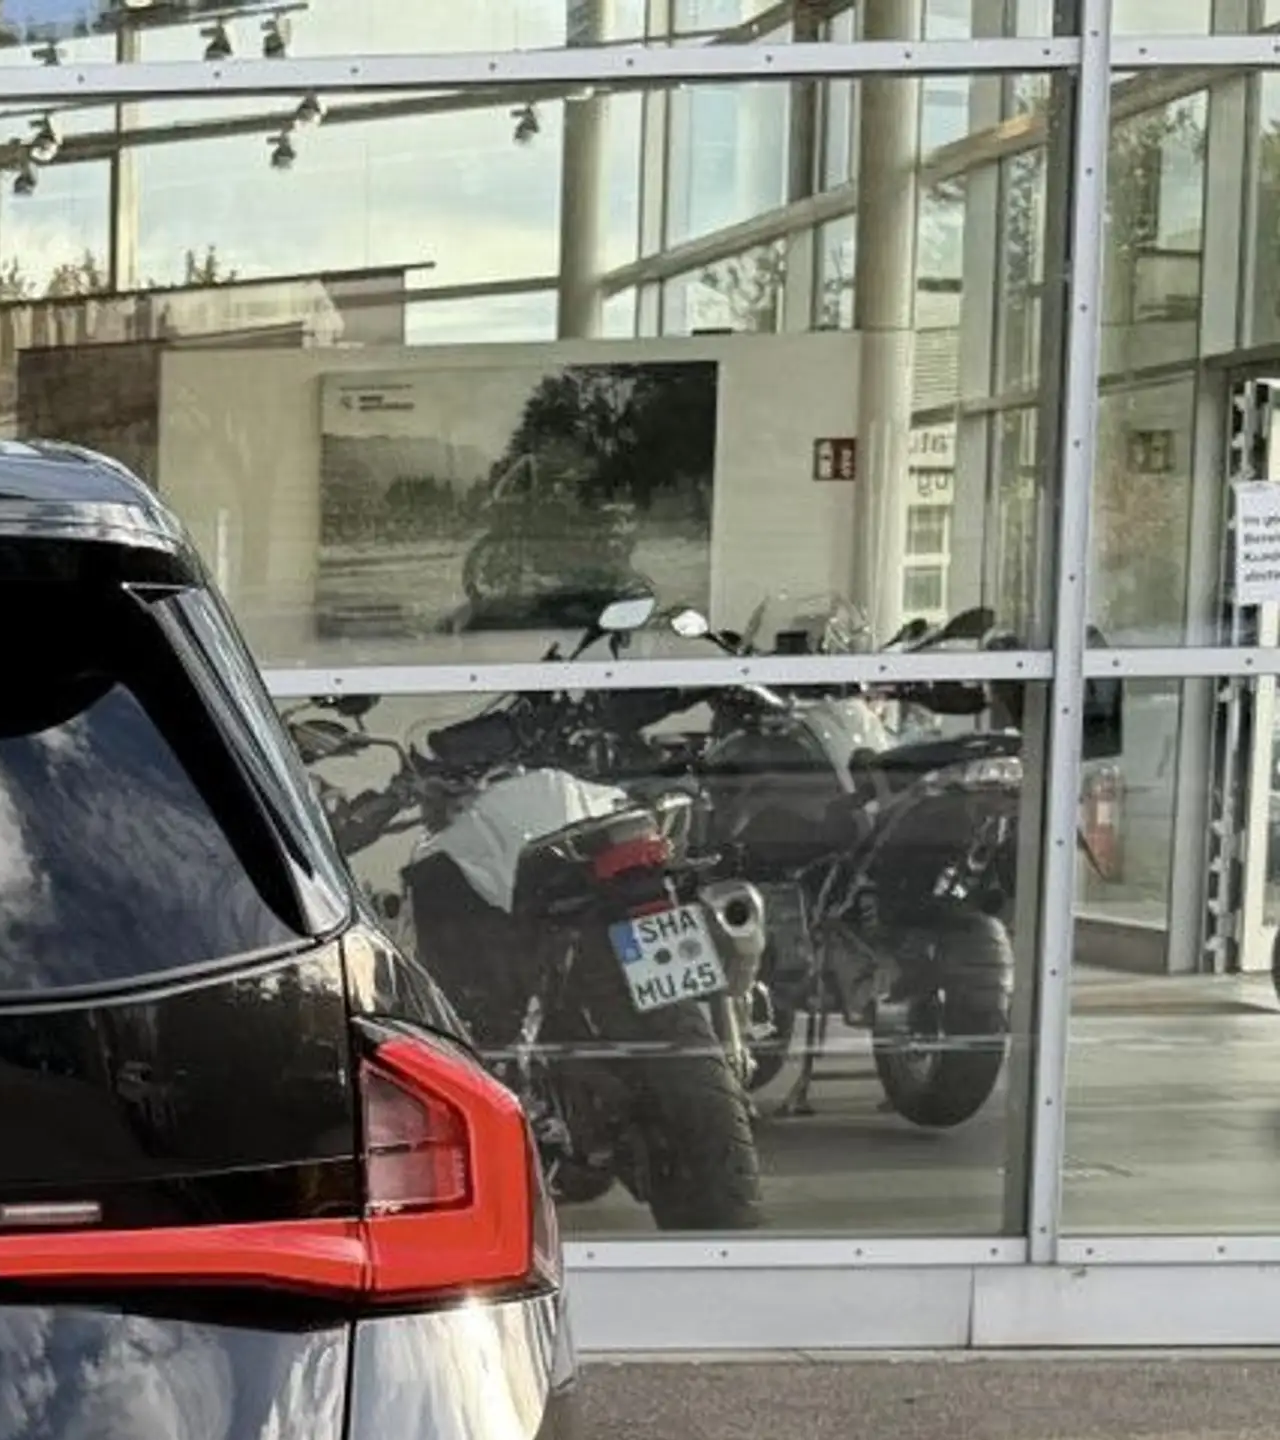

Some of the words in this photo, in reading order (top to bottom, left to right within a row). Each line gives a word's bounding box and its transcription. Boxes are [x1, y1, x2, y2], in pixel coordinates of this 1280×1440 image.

[639, 909, 698, 943] SHA
[636, 973, 676, 1006] MU
[682, 961, 717, 990] 45
